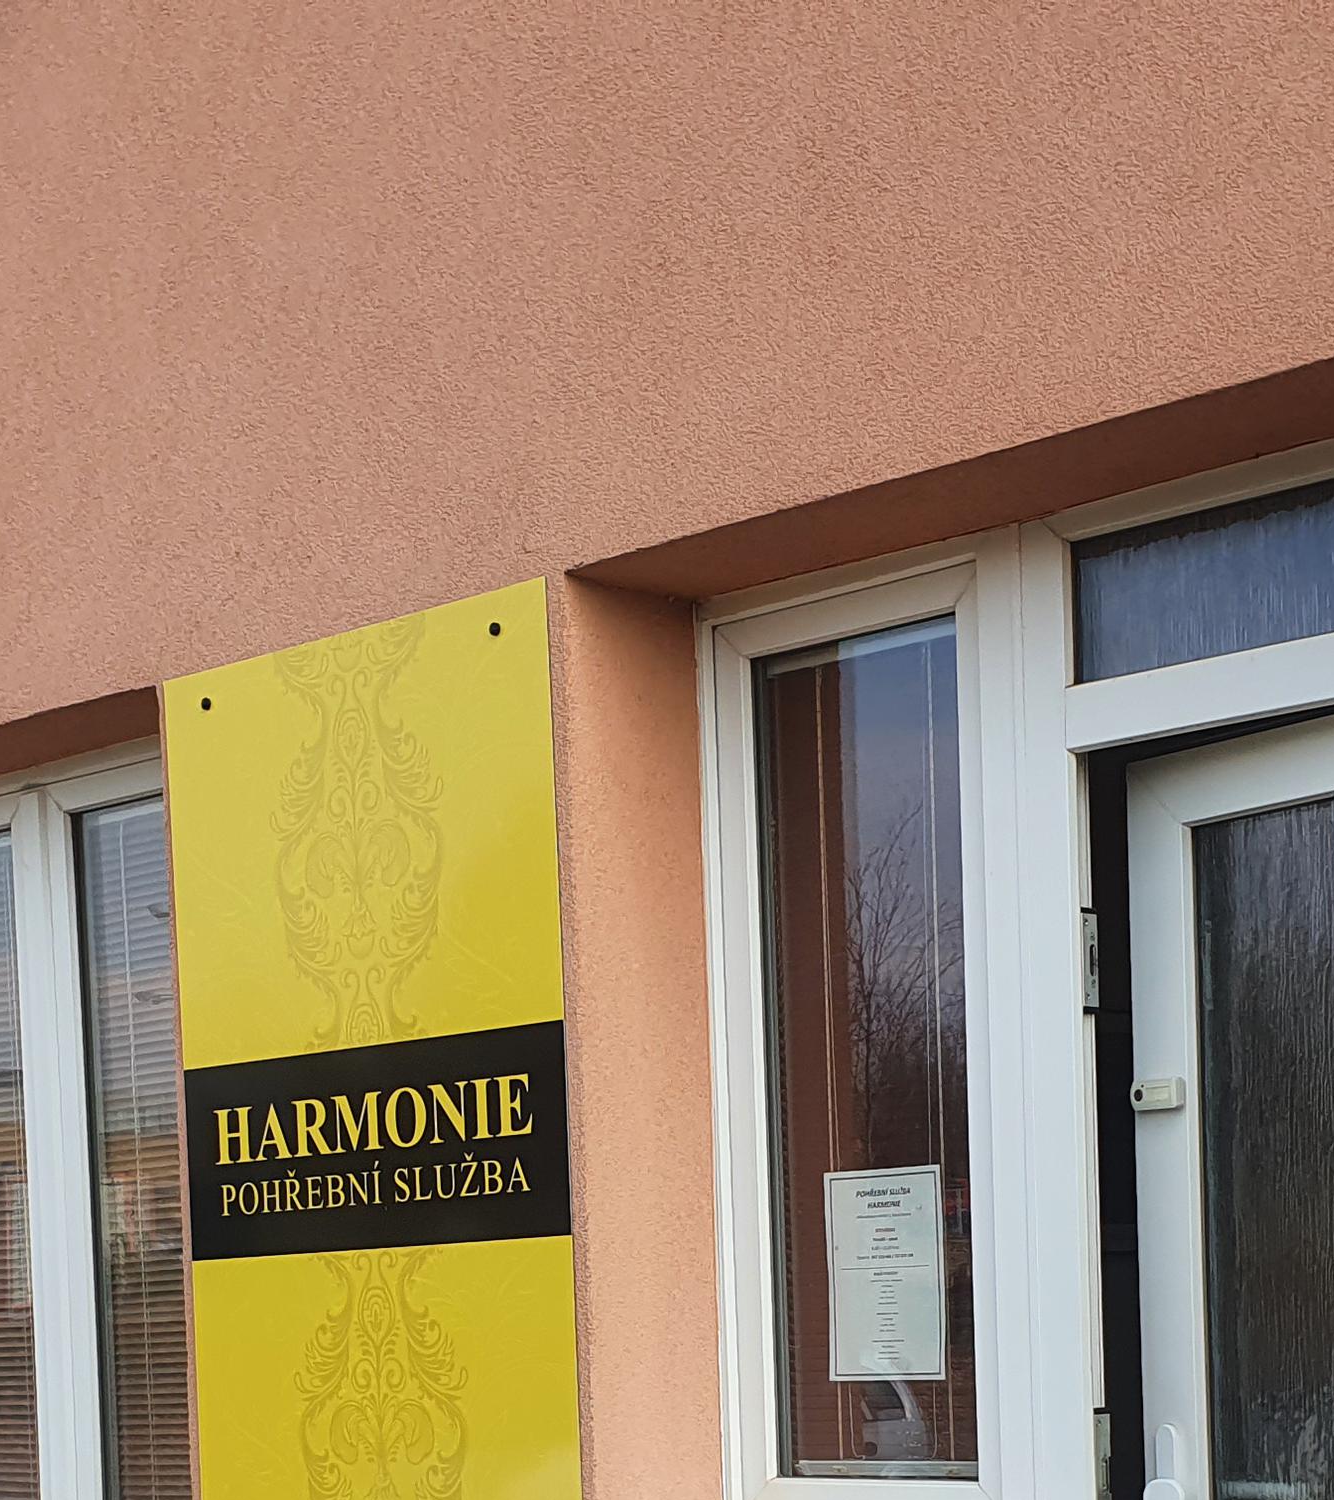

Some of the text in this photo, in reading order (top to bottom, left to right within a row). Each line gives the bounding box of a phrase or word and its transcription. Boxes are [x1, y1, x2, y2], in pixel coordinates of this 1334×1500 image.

[214, 1073, 533, 1166] HARMONIE
[221, 1152, 531, 1217] POHŘEBNÍ SLUŽBA
